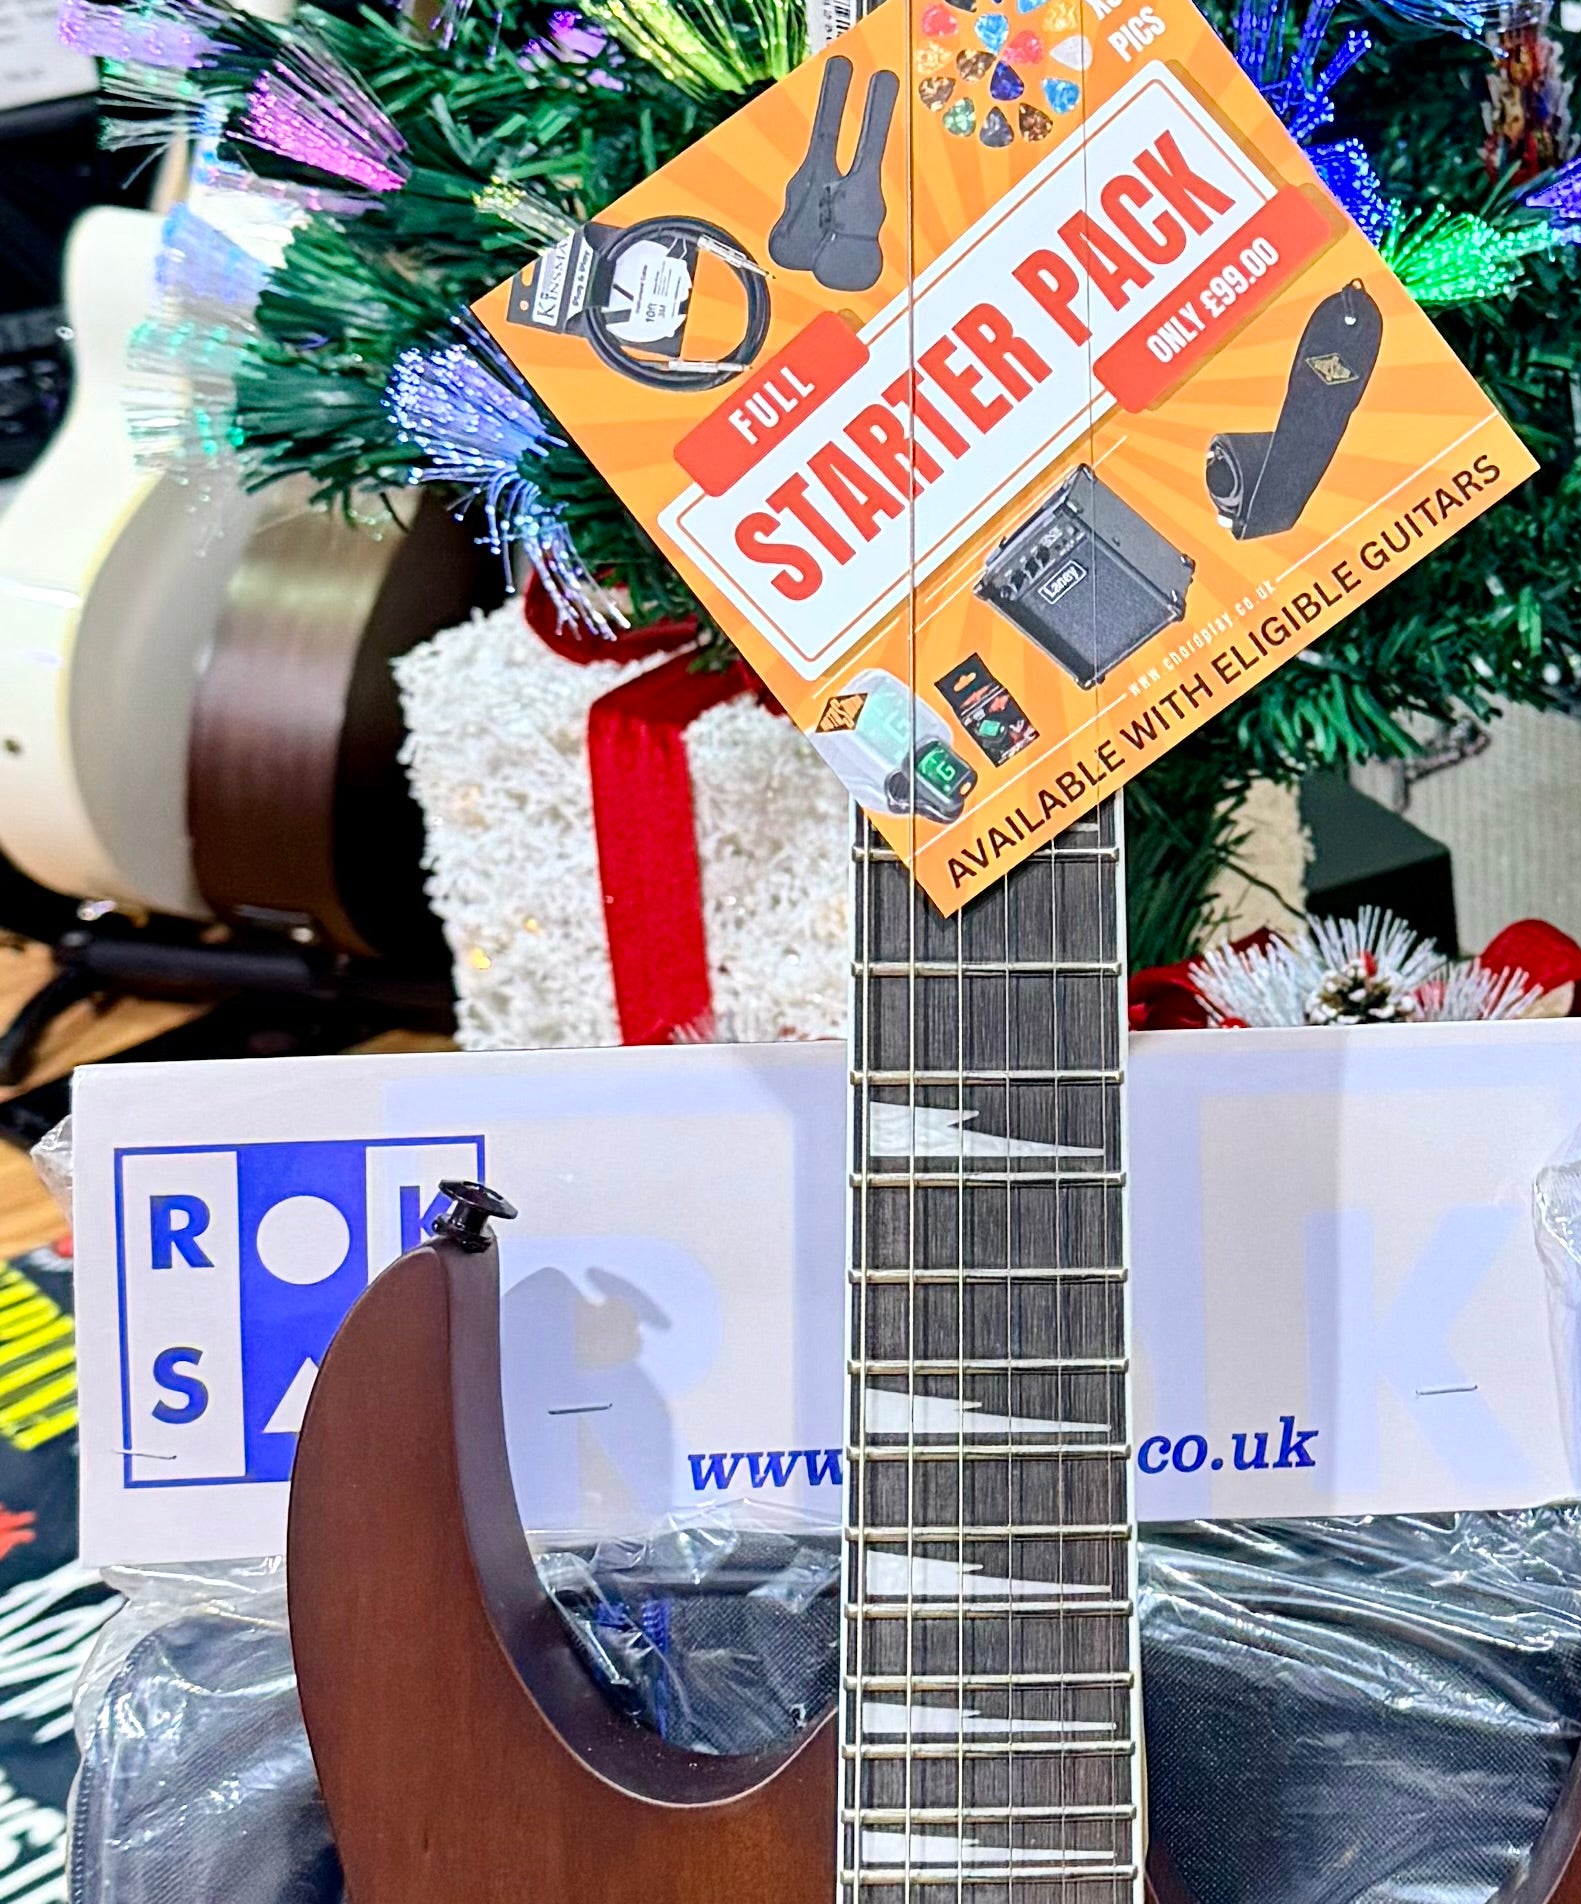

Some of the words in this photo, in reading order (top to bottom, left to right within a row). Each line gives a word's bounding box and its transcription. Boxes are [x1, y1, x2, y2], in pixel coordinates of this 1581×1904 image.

[1108, 7, 1167, 64] PICS
[1146, 308, 1209, 364] ONLY
[1198, 236, 1281, 320] £99.00
[728, 371, 817, 445] FULL
[734, 304, 1054, 602] STARTER
[1014, 130, 1235, 346] PACK
[1045, 565, 1078, 598] Laney
[1128, 580, 1275, 696] www.chordplay.co.uk
[944, 748, 1126, 890] AVAILABLE
[1122, 673, 1213, 756] WITH
[1211, 561, 1362, 684] ELIGIBLE
[1362, 452, 1501, 587] GUITARS
